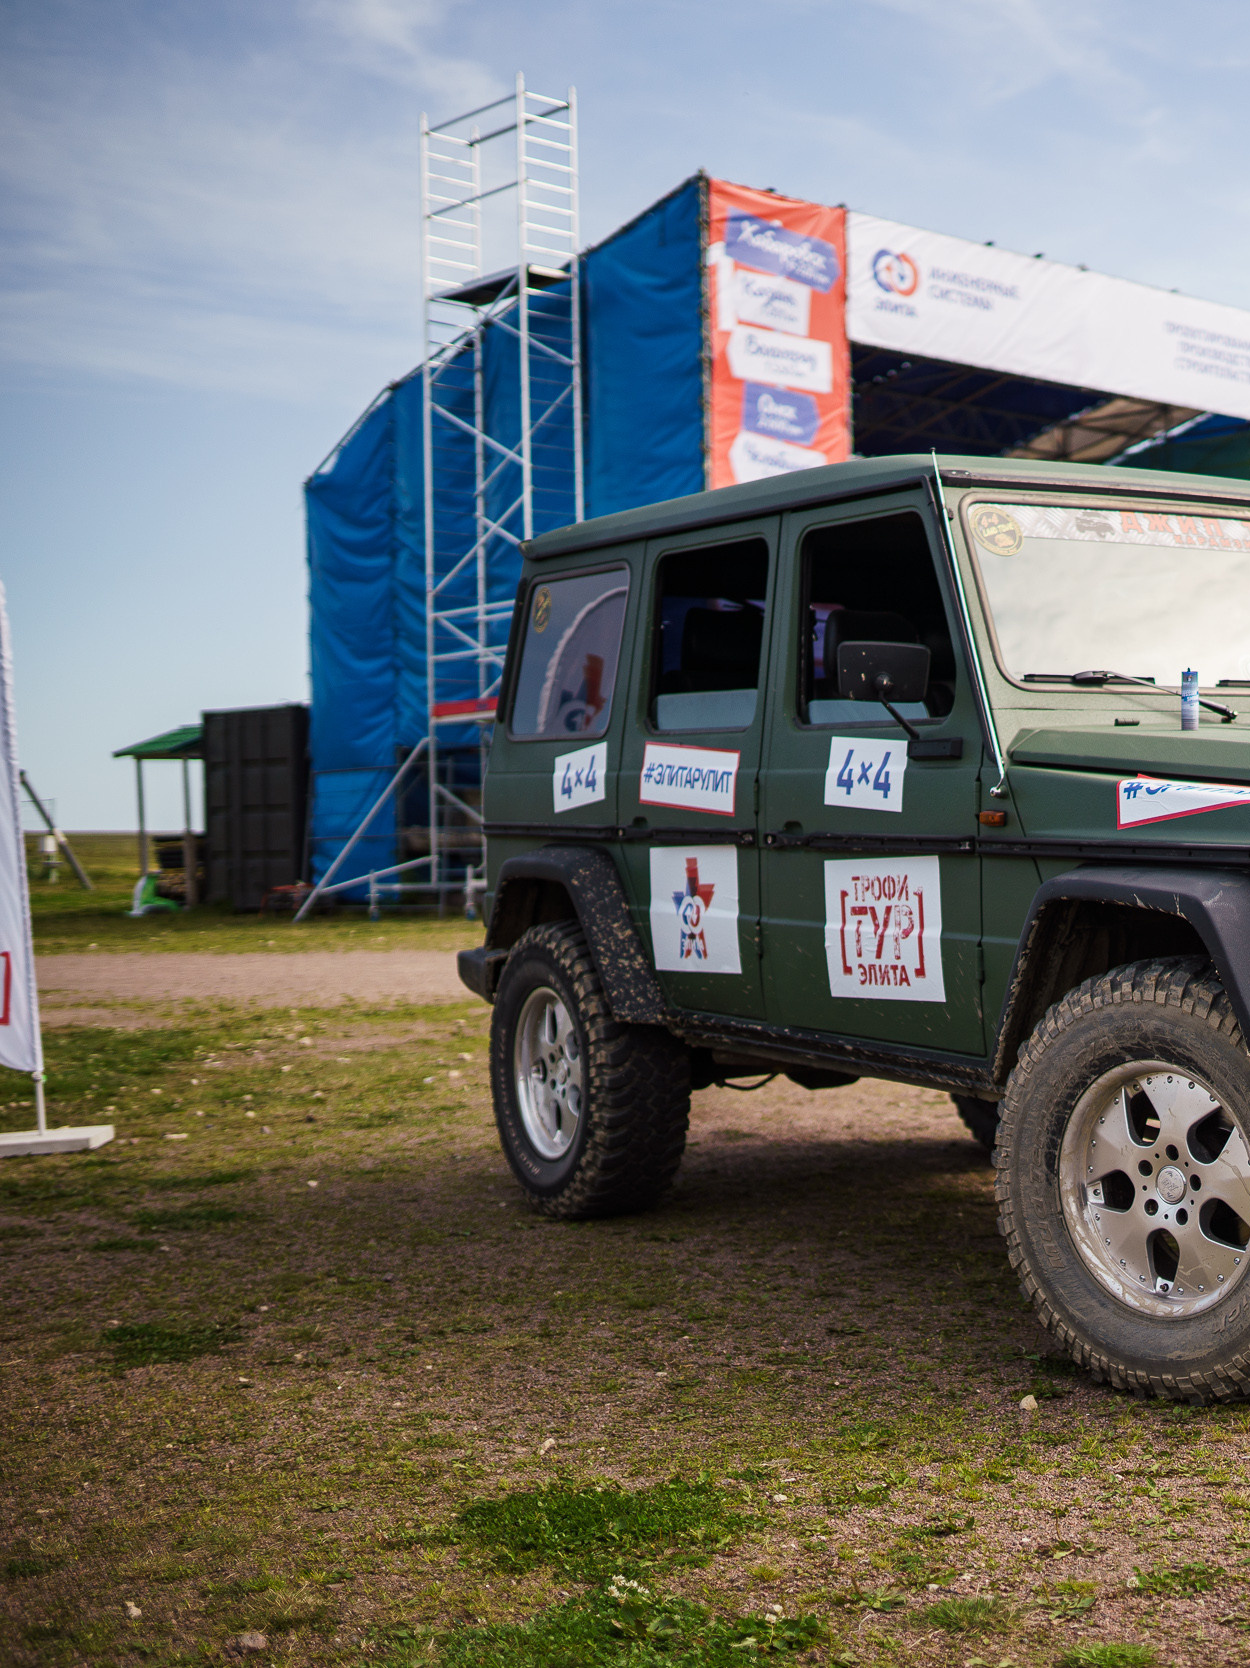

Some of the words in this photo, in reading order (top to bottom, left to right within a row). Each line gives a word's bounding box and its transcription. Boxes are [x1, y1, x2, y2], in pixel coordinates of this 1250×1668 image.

[1119, 511, 1224, 538] ДЖИП
[643, 763, 733, 795] #ЭЛИТАРУЛИТ
[851, 874, 910, 903] ТРОФИ
[857, 963, 911, 988] ЭЛИТА
